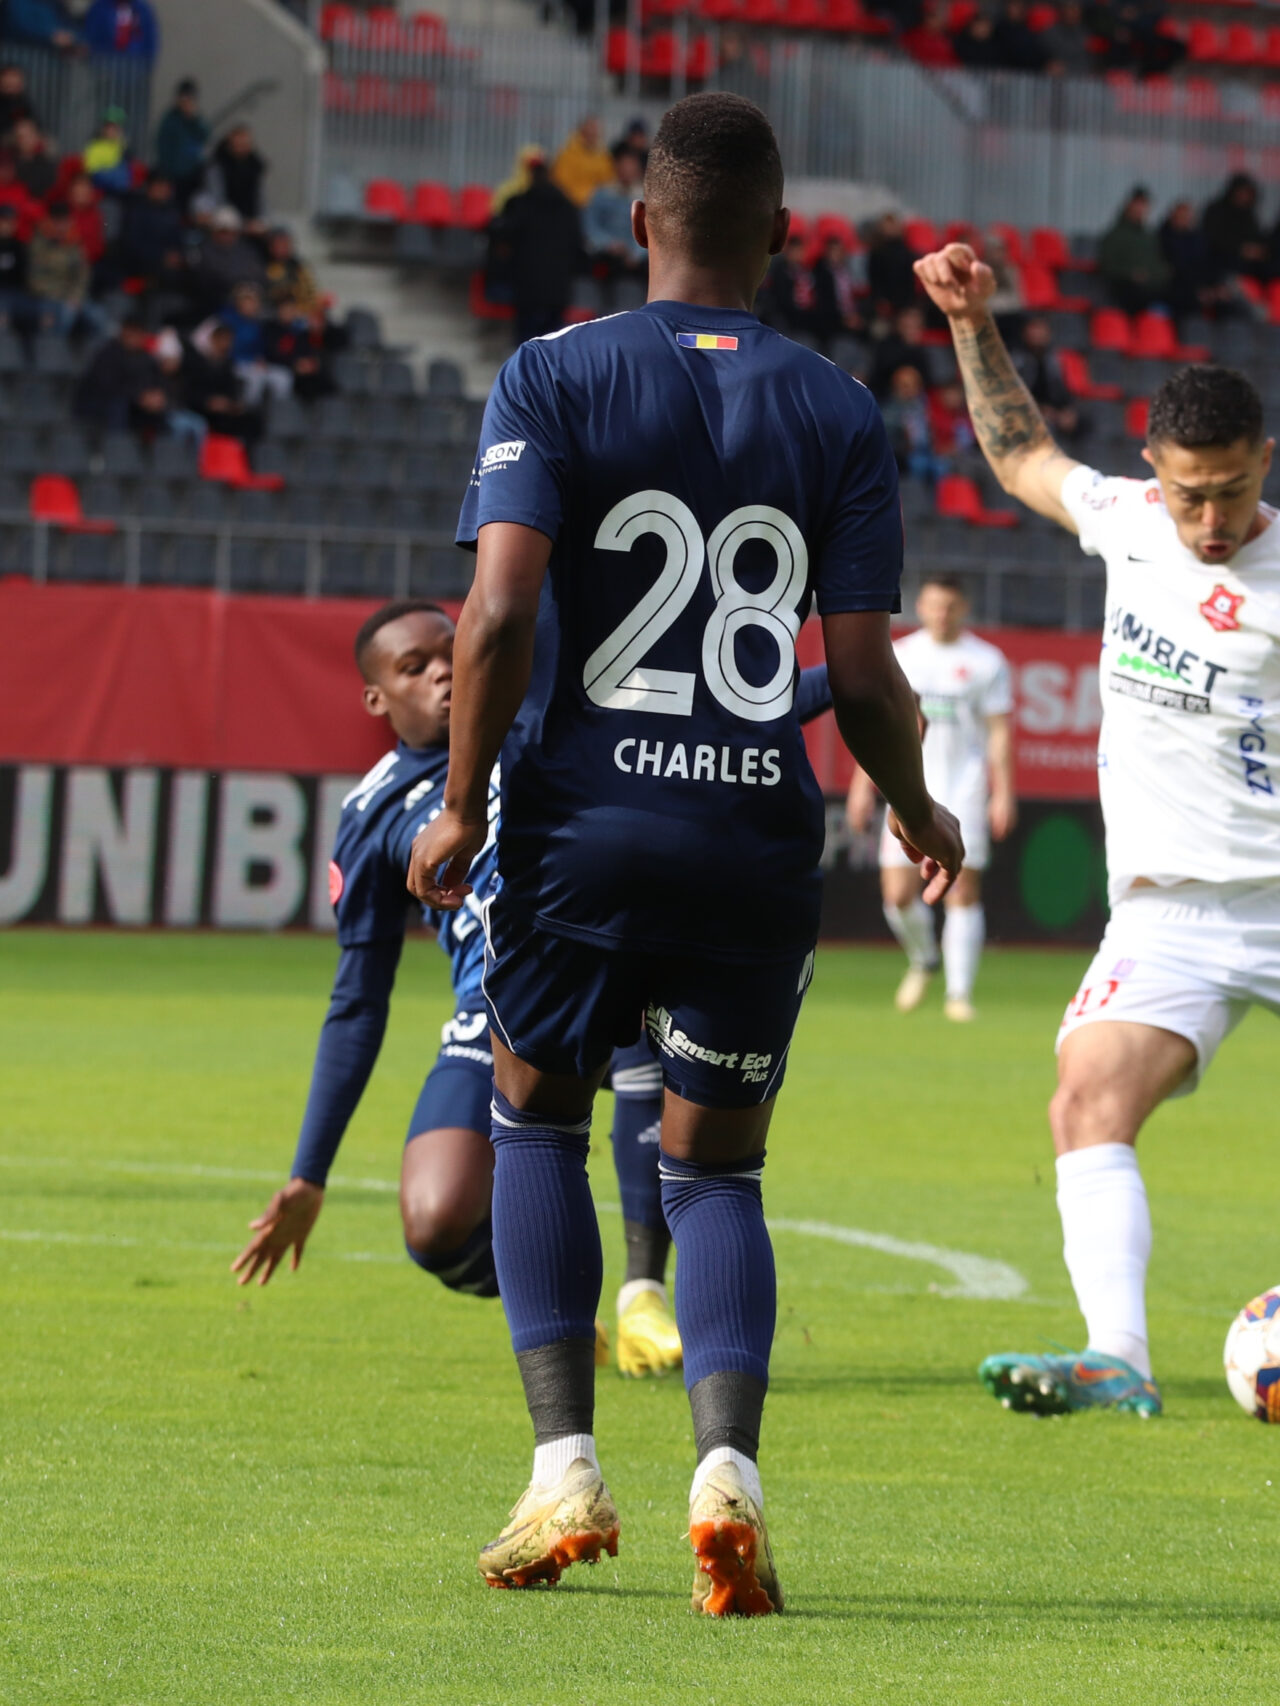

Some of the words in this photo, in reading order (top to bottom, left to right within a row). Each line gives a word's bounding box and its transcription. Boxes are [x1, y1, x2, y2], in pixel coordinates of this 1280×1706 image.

[583, 489, 808, 722] 28
[613, 737, 781, 786] CHARLES
[0, 764, 342, 930] UNIB
[670, 1029, 739, 1069] Smart
[739, 1052, 772, 1071] Eco
[741, 1069, 769, 1083] Plus
